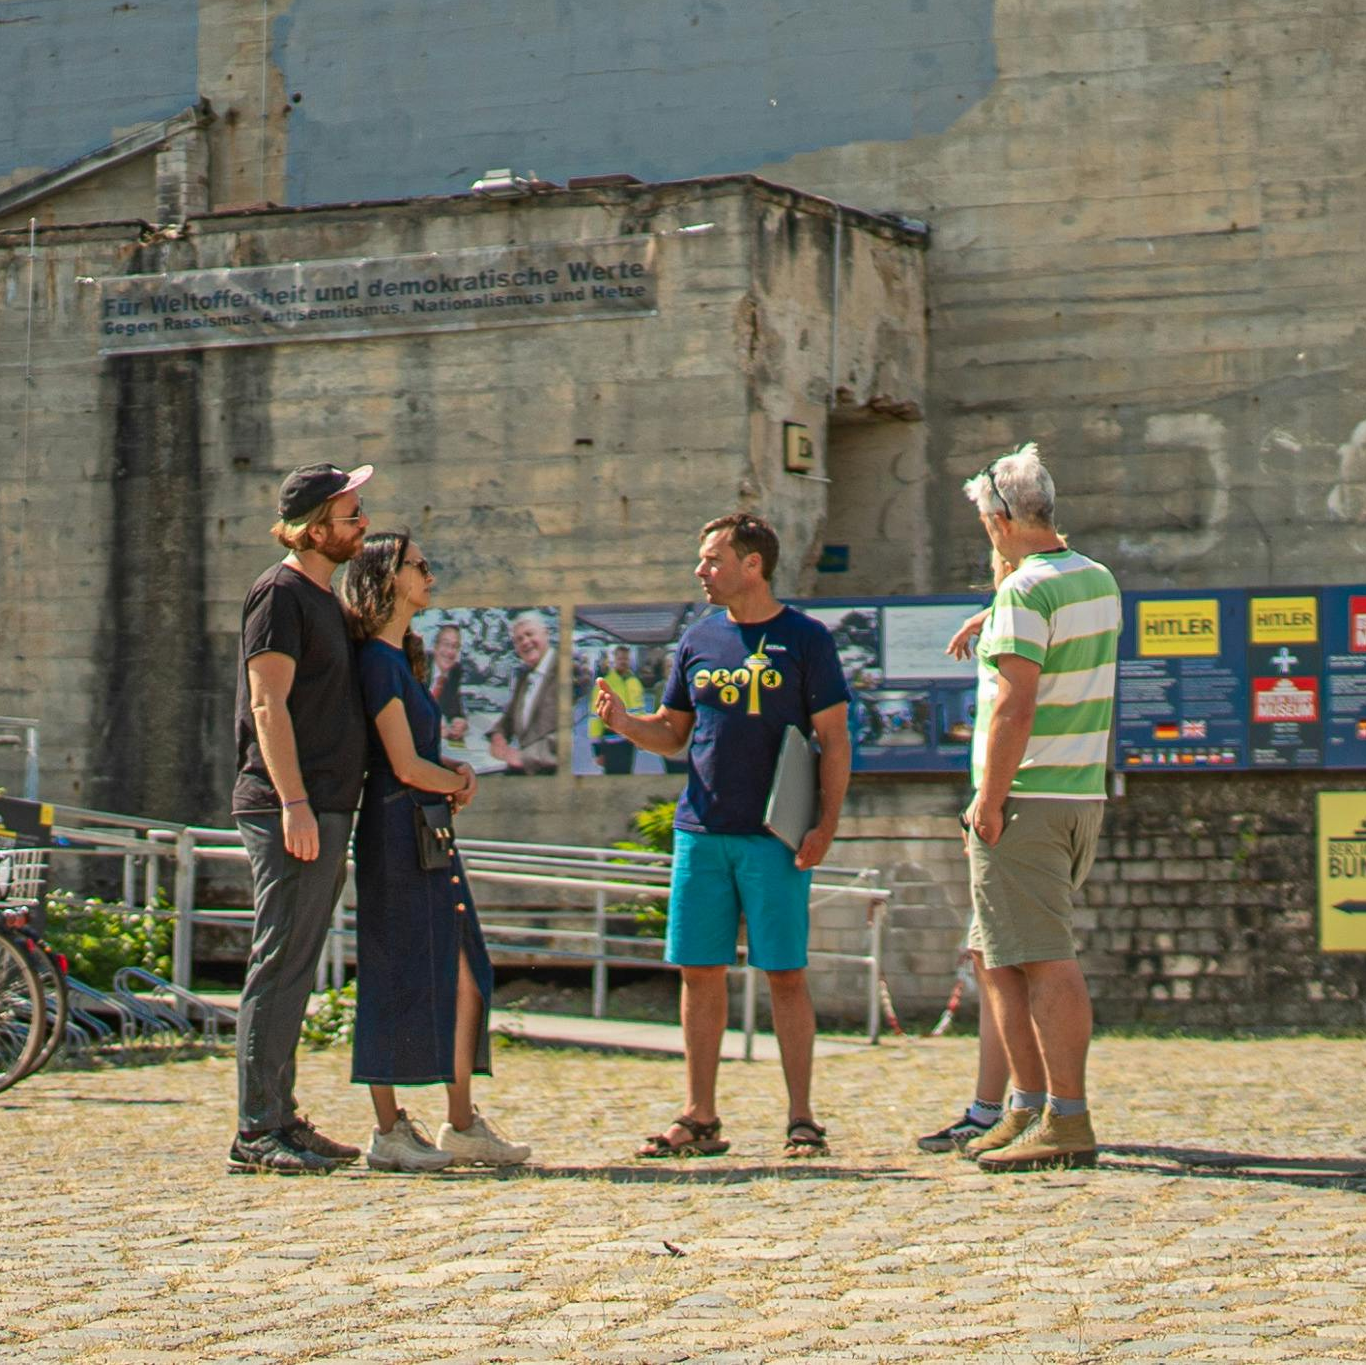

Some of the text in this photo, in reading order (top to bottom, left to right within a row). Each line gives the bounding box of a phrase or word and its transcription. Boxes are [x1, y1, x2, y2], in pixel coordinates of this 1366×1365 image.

[103, 260, 645, 317] Für Weltoffenheit und demokratische Werte
[103, 321, 158, 337] Gegen
[412, 289, 545, 313] Nationalismus
[551, 286, 585, 303] und
[591, 285, 647, 300] Hetze
[1145, 618, 1215, 636] HITLER
[1256, 612, 1313, 627] HITLER
[1258, 703, 1315, 717] MUSEUM
